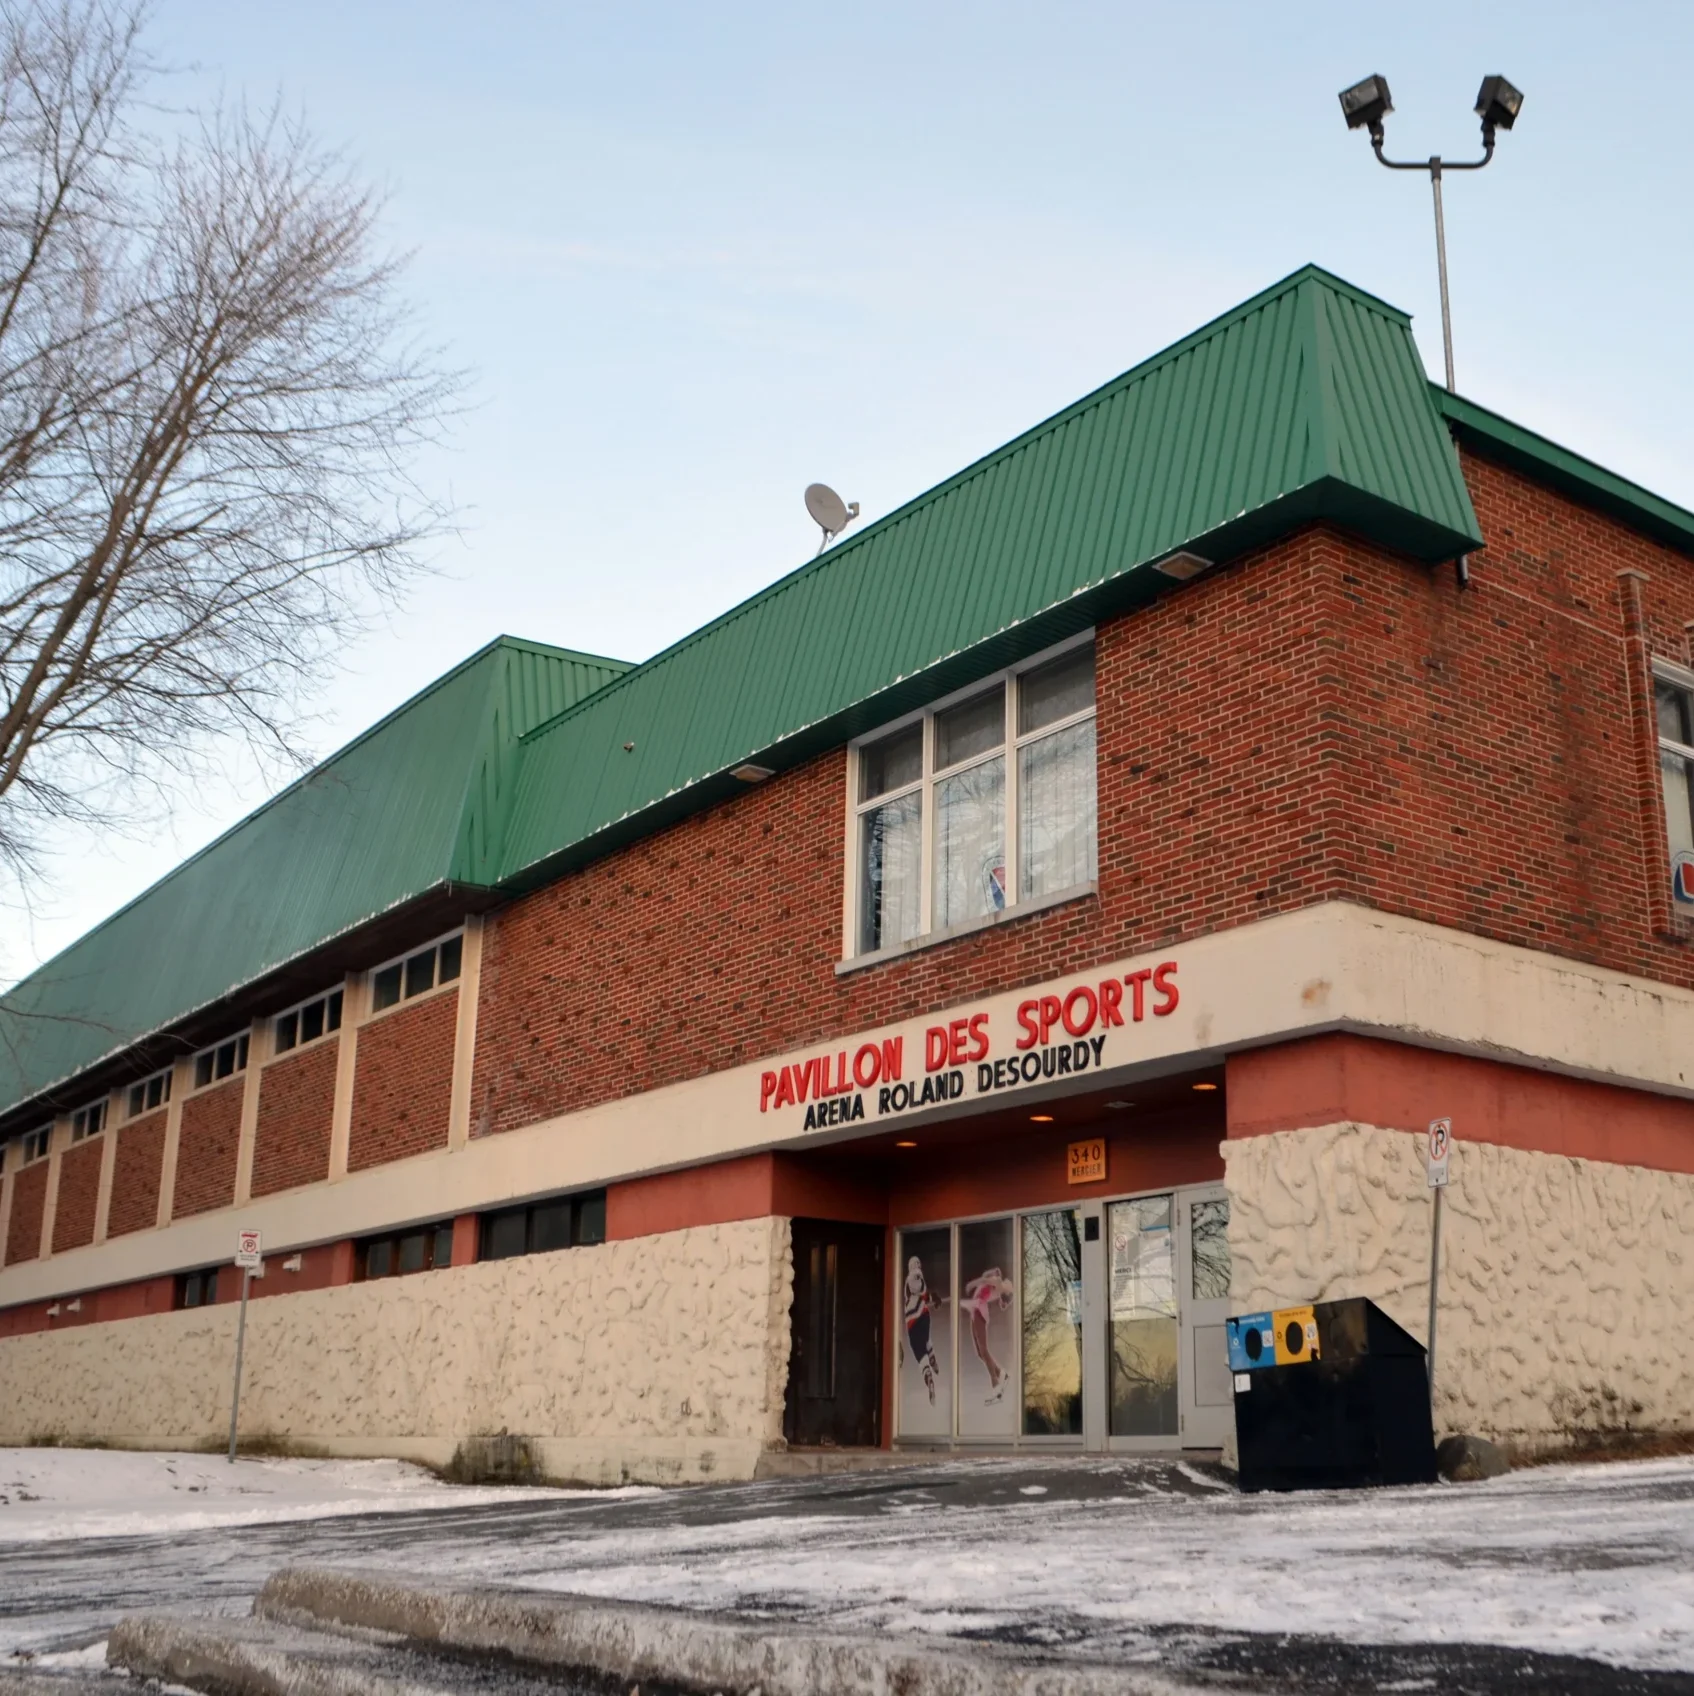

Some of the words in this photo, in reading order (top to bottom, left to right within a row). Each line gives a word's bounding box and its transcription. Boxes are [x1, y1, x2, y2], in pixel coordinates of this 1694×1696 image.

[760, 1035, 903, 1112] PAVILLON
[925, 1013, 989, 1073] DES
[1016, 961, 1179, 1050] SPORTS
[803, 1093, 865, 1130] ARENA
[878, 1069, 964, 1114] ROLAND
[978, 1034, 1107, 1093] DESOURDY
[1071, 1144, 1101, 1164] 340
[1071, 1163, 1101, 1177] MERCIER
